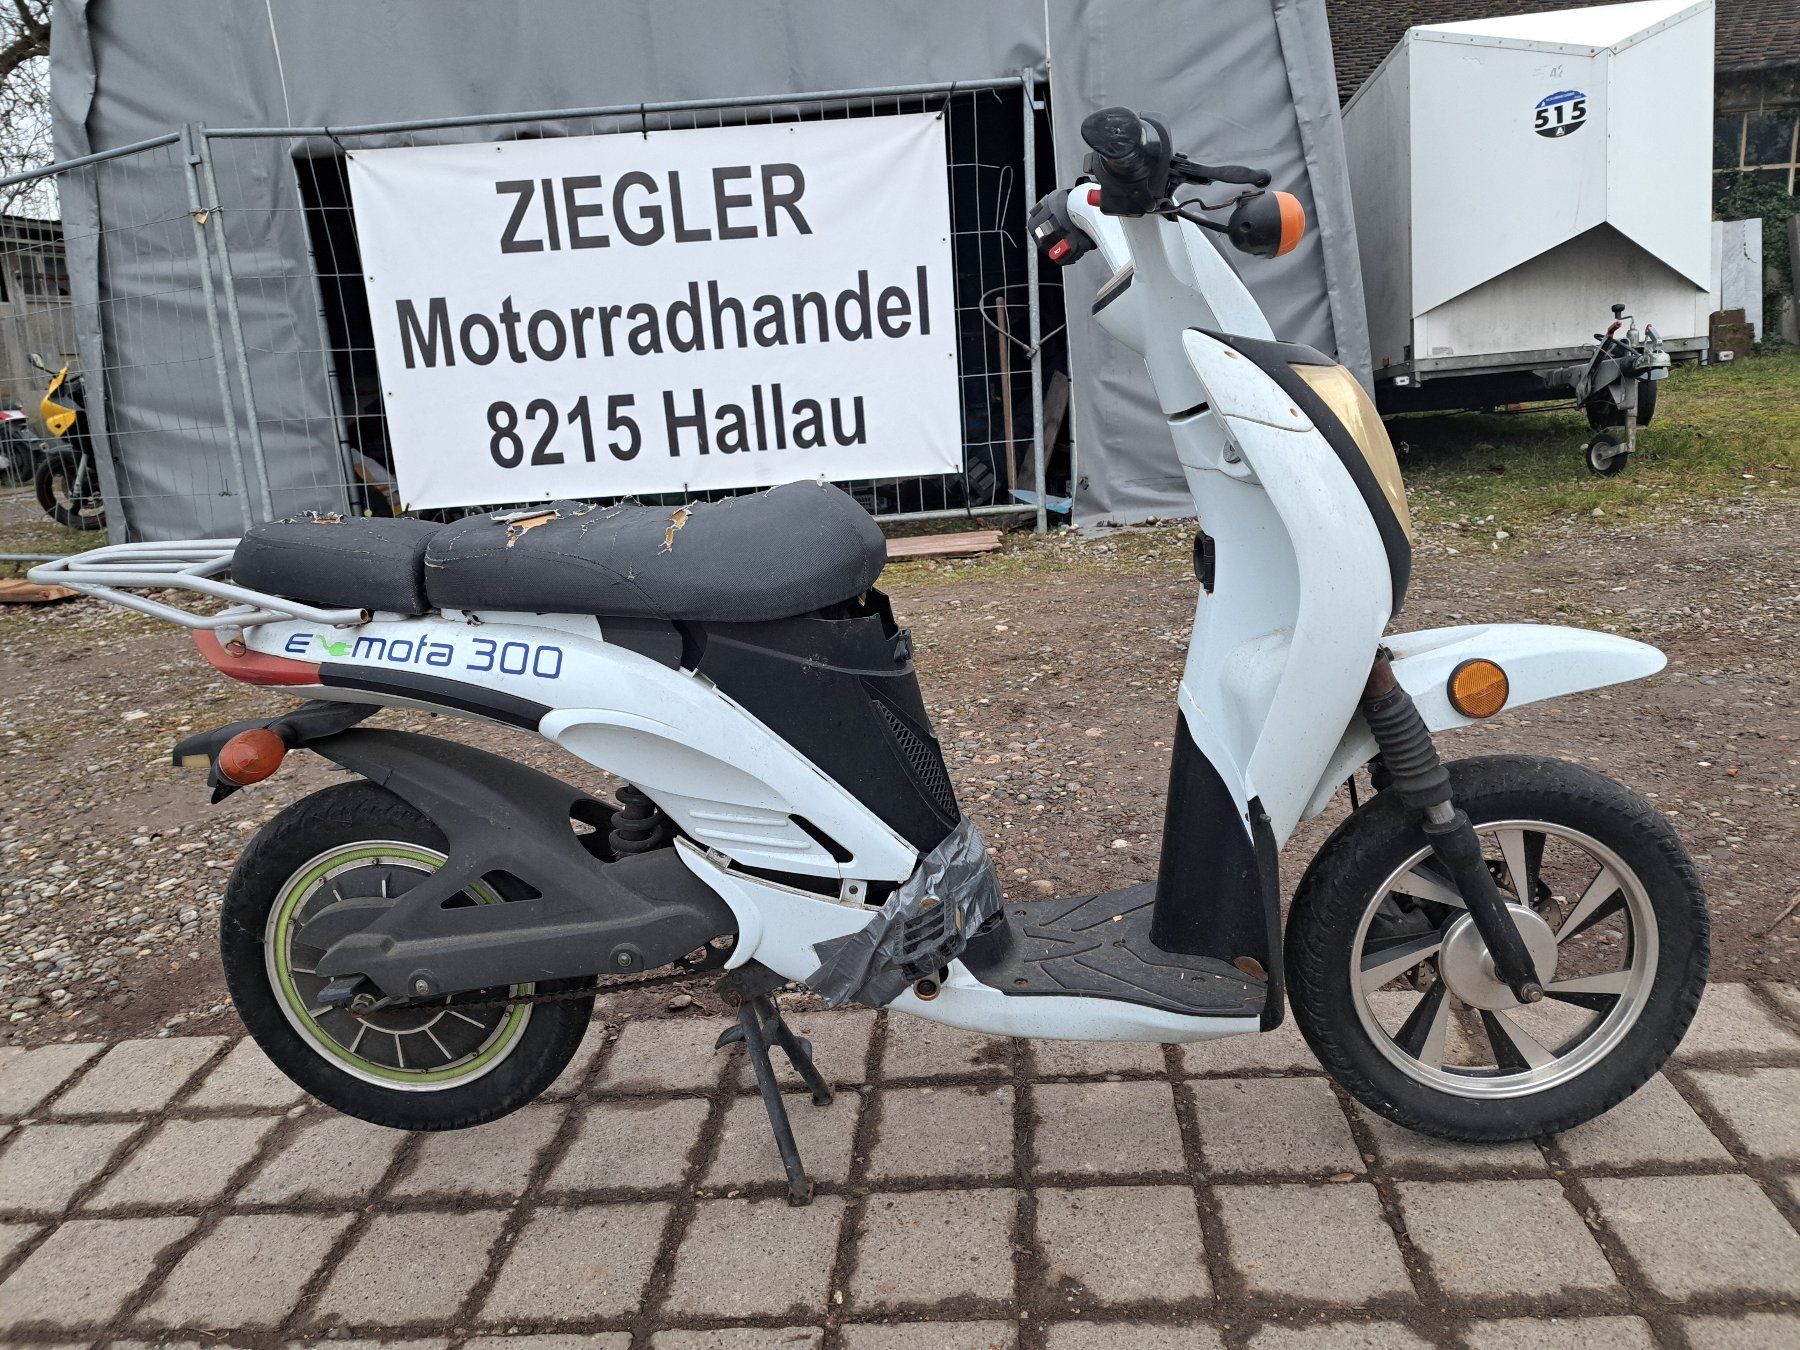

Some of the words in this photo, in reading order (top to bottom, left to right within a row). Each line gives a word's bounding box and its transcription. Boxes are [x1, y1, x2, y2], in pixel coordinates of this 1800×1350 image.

[1534, 99, 1587, 129] 515
[495, 162, 813, 255] ZIEGLER
[395, 265, 931, 369] Motorradhandel
[486, 393, 643, 469] 8215
[662, 382, 868, 458] Hallau
[466, 637, 563, 680] 300
